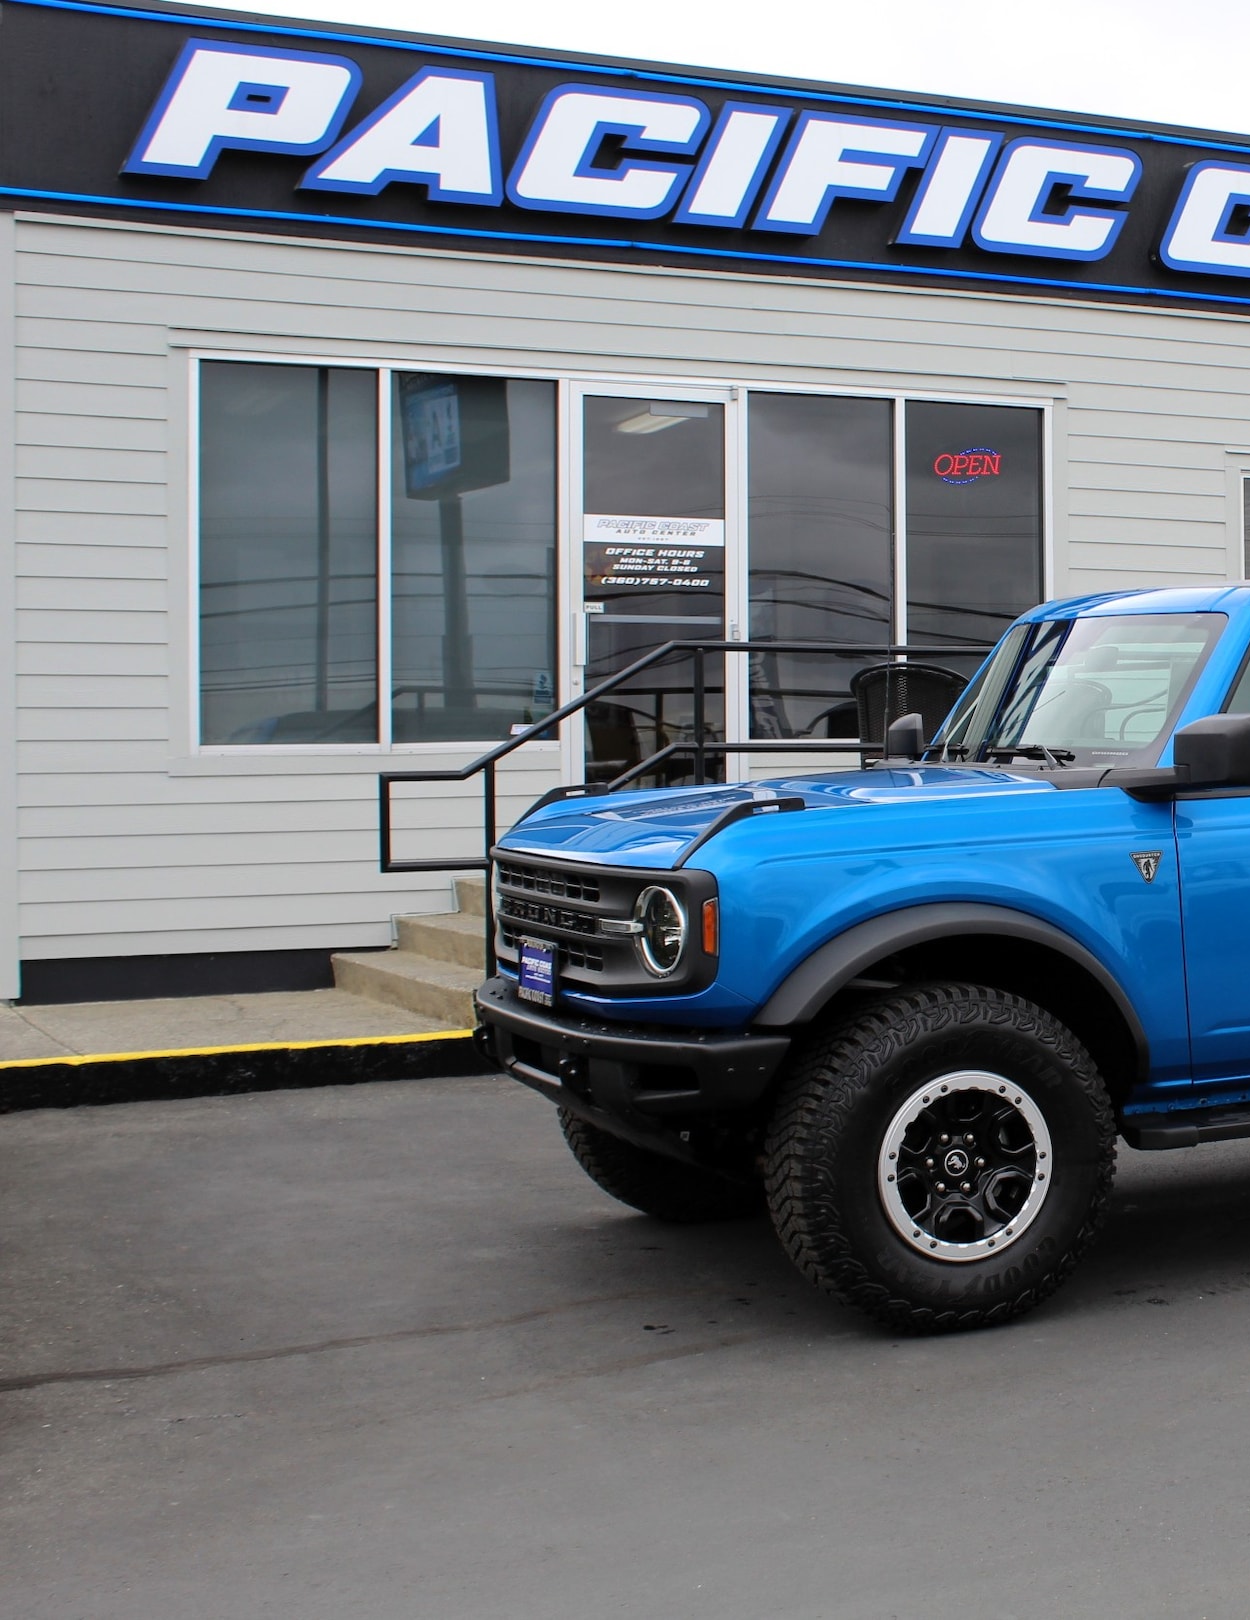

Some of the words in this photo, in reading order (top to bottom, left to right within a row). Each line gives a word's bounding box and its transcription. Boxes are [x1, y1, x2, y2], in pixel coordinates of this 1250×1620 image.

[124, 37, 1142, 261] PACIFIC
[933, 452, 1002, 476] OPEN
[597, 518, 657, 530] PACIFIC
[658, 521, 710, 532] COAST
[605, 547, 655, 557] OFFICE
[657, 549, 704, 558] HOURS
[612, 563, 655, 571] SUNDAY
[656, 565, 699, 573] CLOSED
